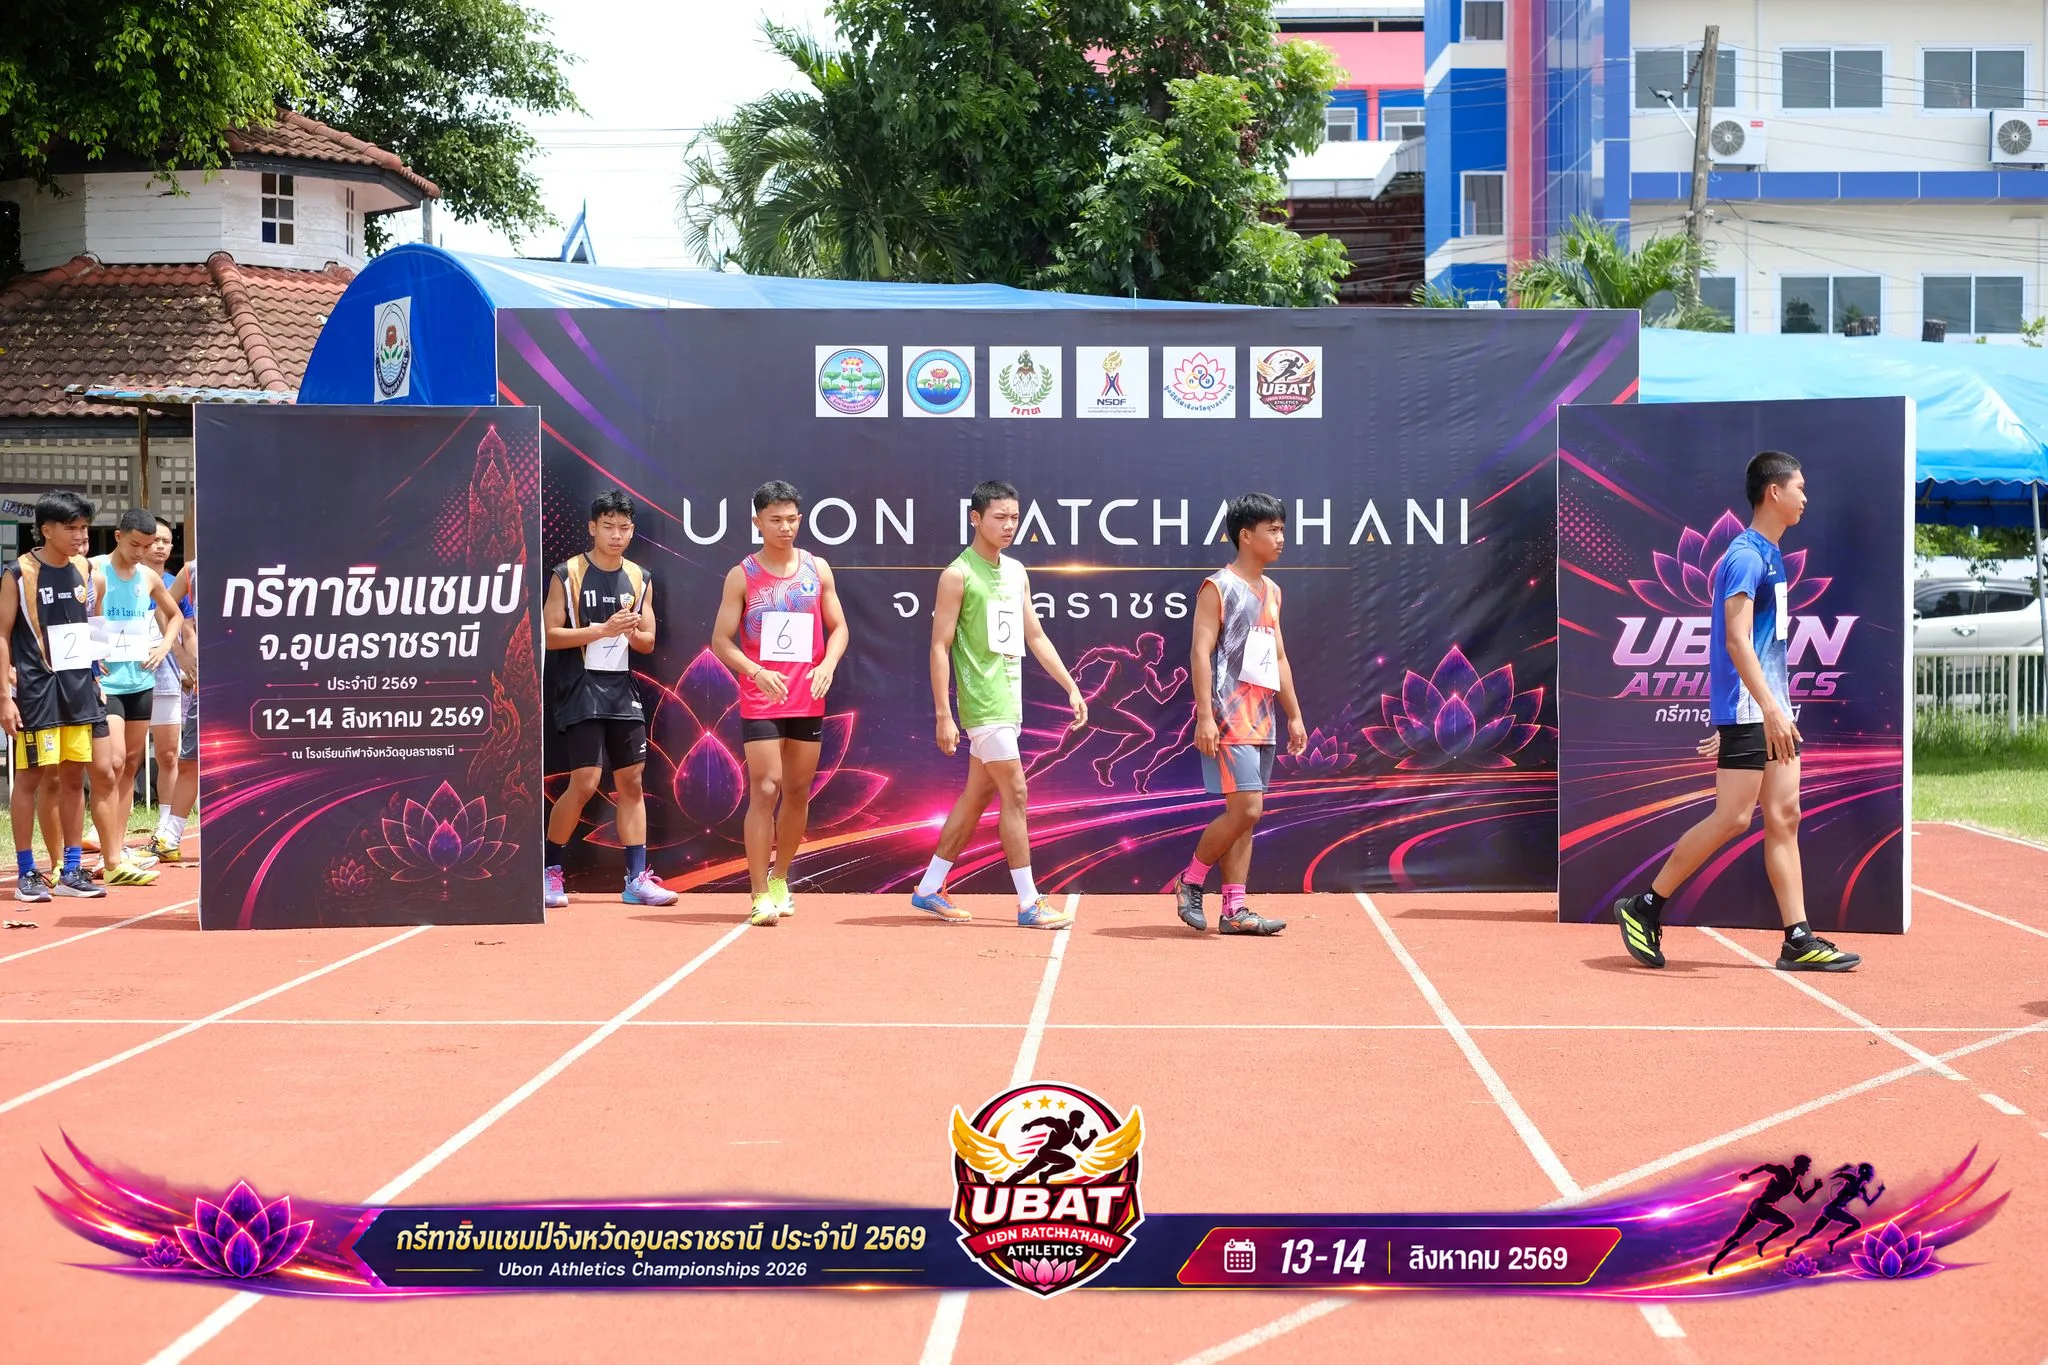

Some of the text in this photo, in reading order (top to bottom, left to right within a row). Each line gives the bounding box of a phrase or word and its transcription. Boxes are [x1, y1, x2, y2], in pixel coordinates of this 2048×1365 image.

[1262, 383, 1311, 396] UBAT
[1096, 398, 1127, 406] NSDF
[683, 497, 914, 546] UON
[39, 586, 54, 604] 12
[222, 563, 524, 617] กรีฑาชิงแชมป์
[584, 590, 597, 607] 11
[776, 619, 793, 649] 6
[997, 610, 1014, 643] 5
[63, 632, 79, 660] 2
[115, 629, 131, 653] 4
[259, 621, 481, 671] จ.อุบลราชธานี
[1612, 615, 1860, 666] UBN
[1260, 648, 1272, 673] 4
[327, 675, 418, 691] ประจำปี 2569
[341, 706, 422, 729] สิงหาคม
[430, 706, 484, 727] 2569
[292, 745, 455, 761] ณ โรงเรียนกีฬาจังหวัดอุบลราชธานี
